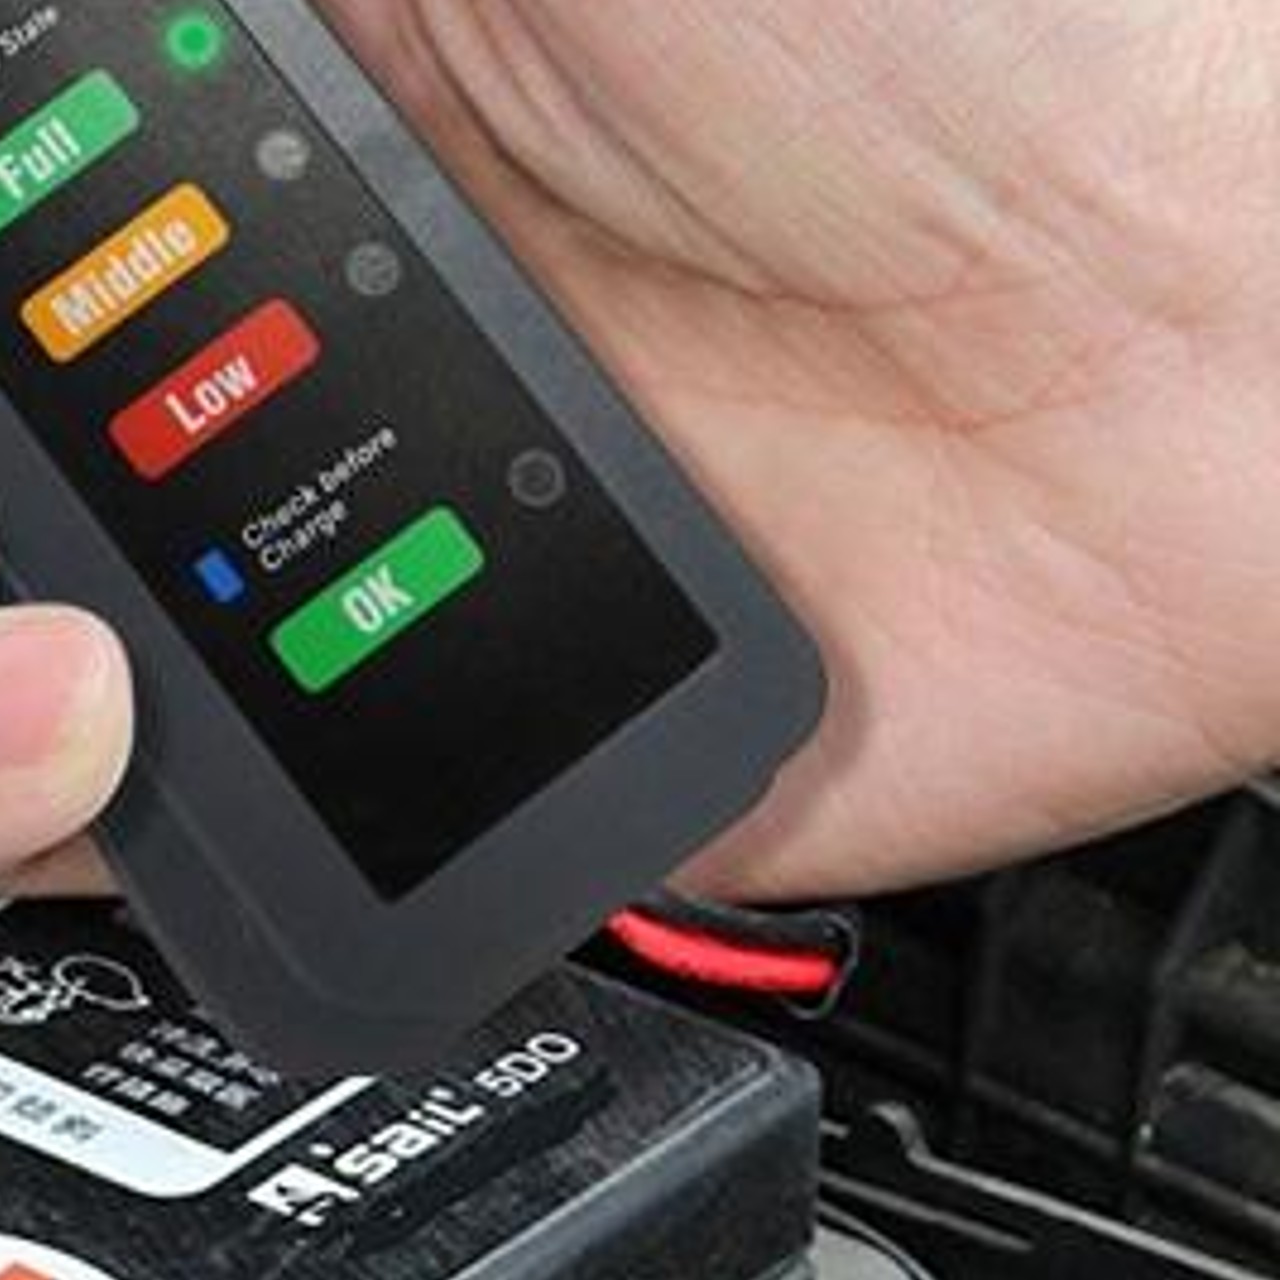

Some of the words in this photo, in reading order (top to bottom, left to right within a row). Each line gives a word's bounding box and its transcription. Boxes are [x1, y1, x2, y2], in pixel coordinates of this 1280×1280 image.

[49, 216, 198, 336] Middle
[163, 354, 258, 436] Low
[241, 483, 319, 550] Check
[260, 499, 346, 572] Charge
[342, 563, 414, 635] OK
